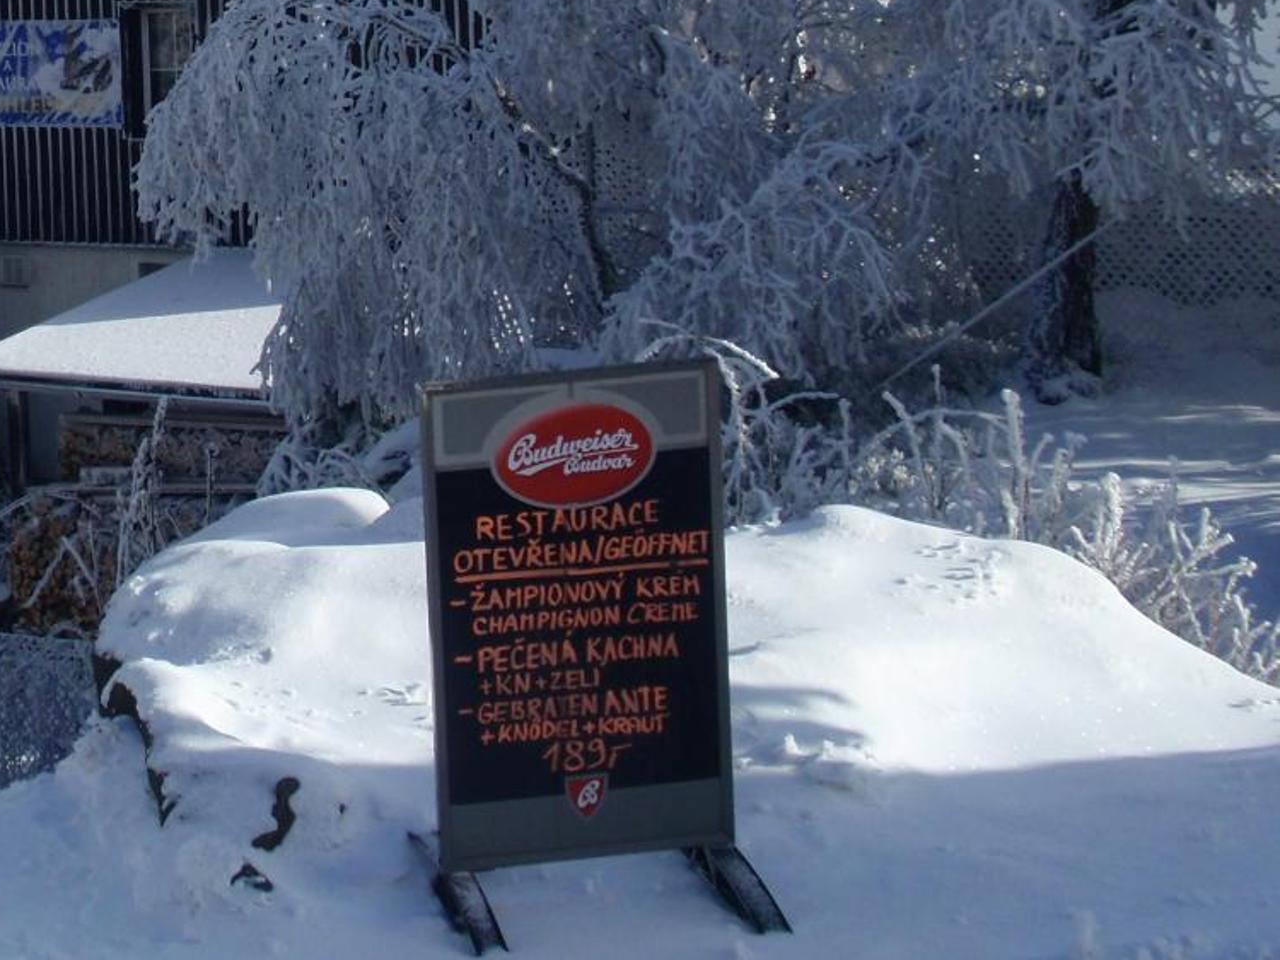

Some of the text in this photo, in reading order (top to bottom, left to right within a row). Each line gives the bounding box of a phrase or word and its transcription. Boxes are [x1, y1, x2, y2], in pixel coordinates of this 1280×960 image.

[508, 428, 638, 473] Budweiser
[563, 454, 636, 475] Budvar
[476, 500, 659, 540] RESTAURACE
[472, 602, 698, 636] CHAMPIGNON CREME
[477, 630, 577, 672] PEČENÁ
[587, 632, 679, 666] KACHNA
